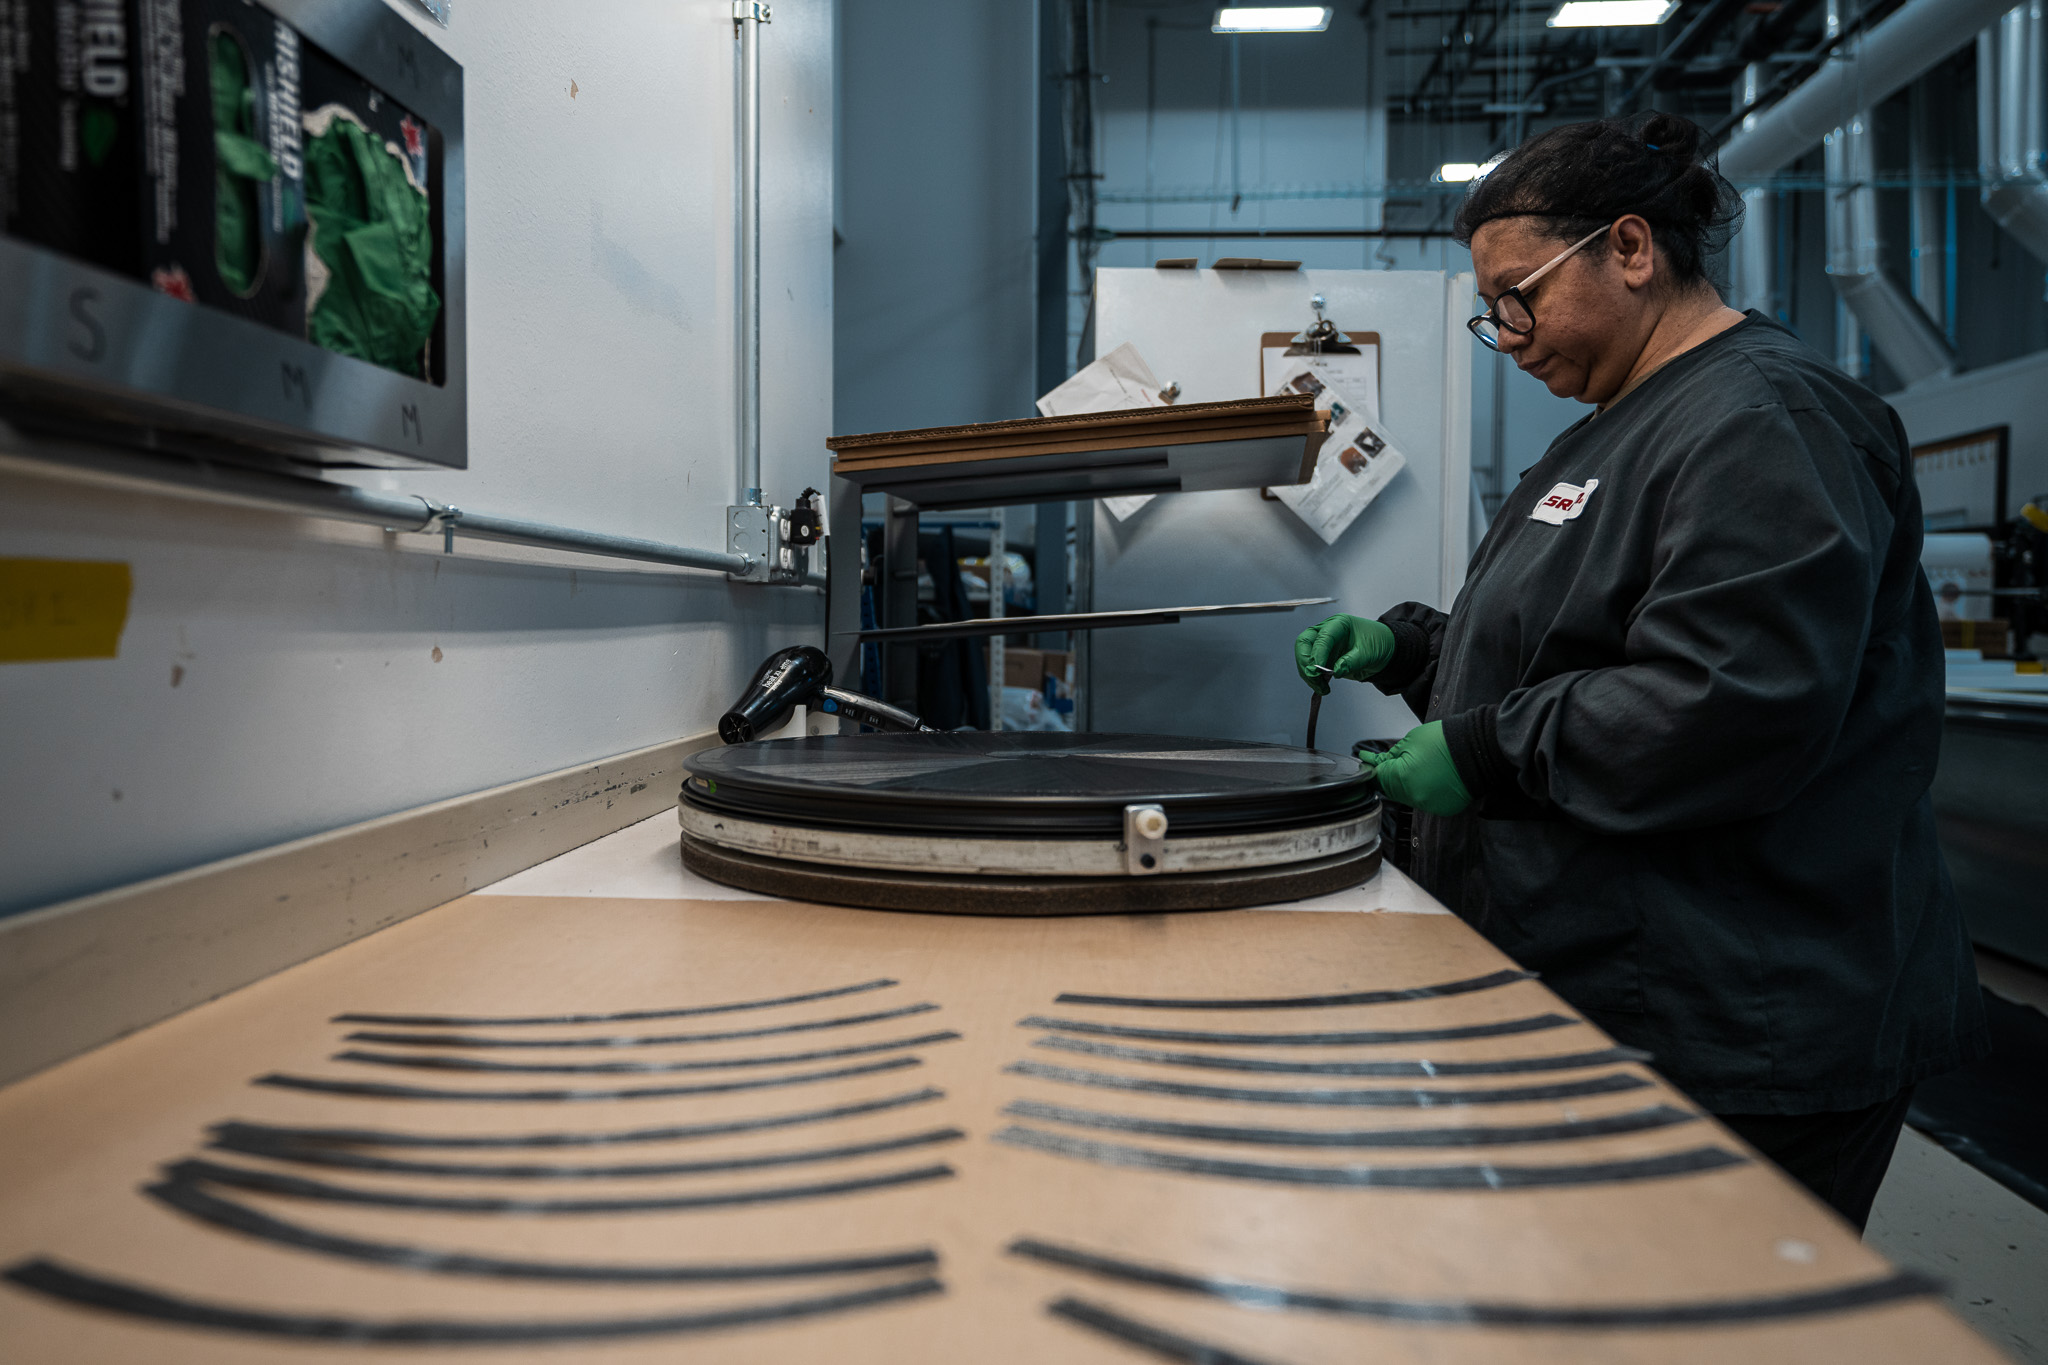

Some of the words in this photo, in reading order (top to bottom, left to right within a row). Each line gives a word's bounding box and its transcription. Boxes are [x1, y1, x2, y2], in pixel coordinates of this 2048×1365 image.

[82, 0, 128, 97] IELD
[68, 287, 107, 363] S
[281, 362, 314, 412] M
[402, 404, 423, 445] M
